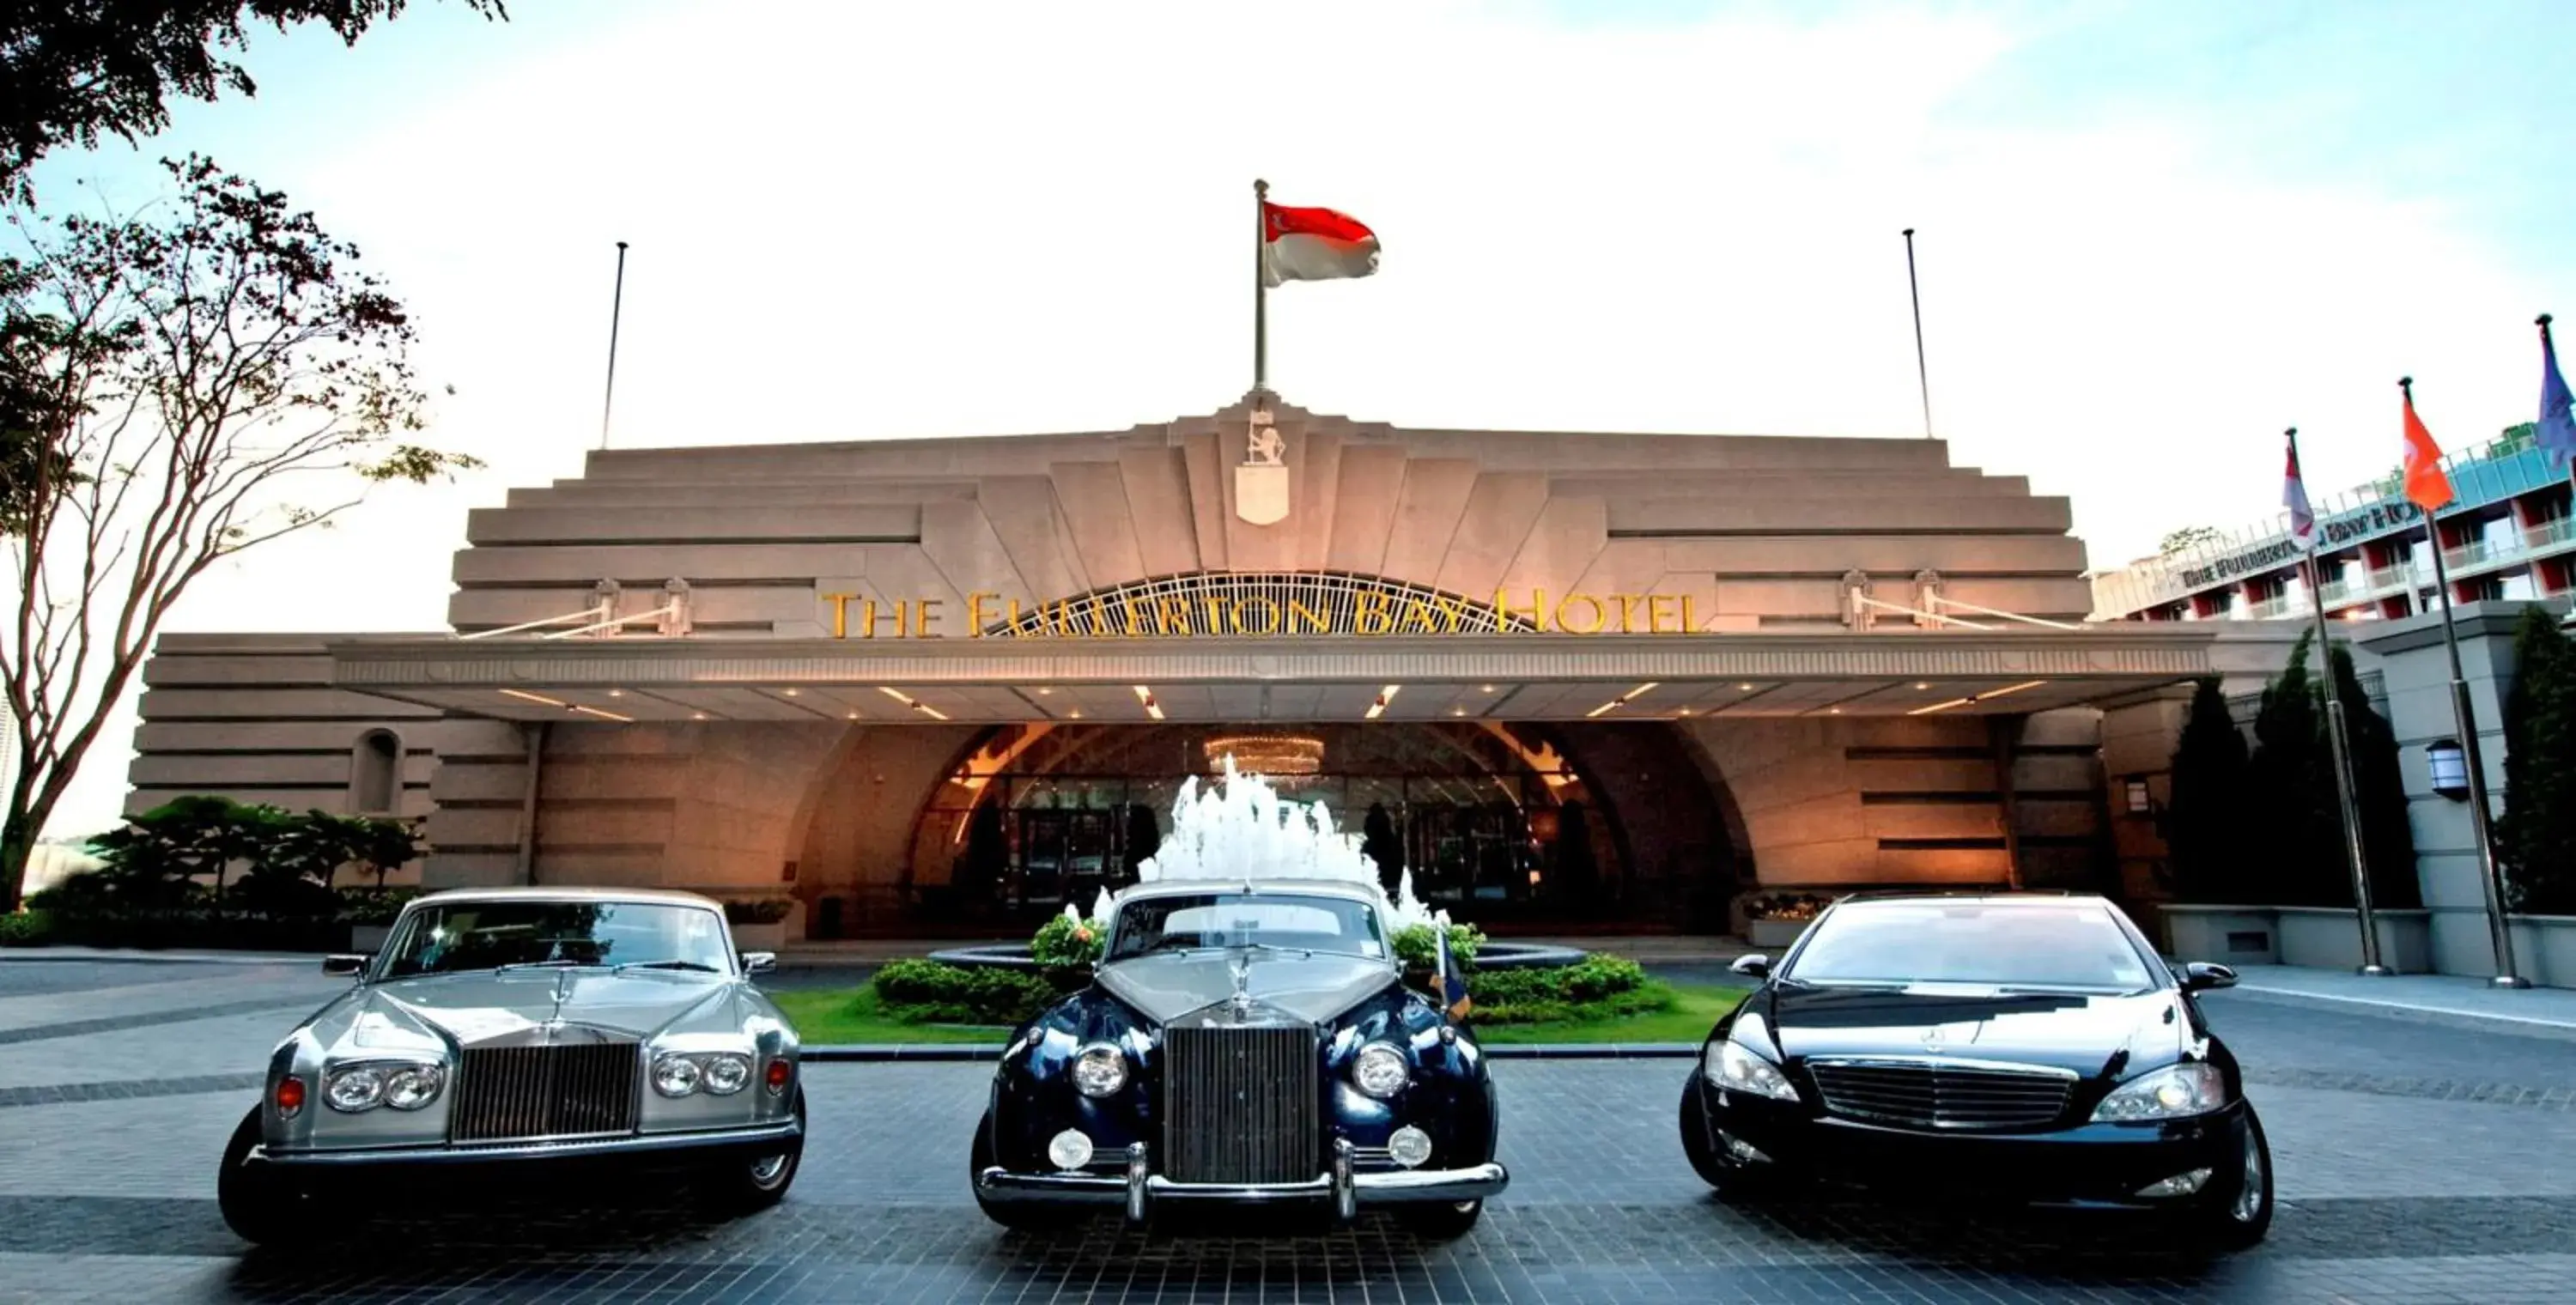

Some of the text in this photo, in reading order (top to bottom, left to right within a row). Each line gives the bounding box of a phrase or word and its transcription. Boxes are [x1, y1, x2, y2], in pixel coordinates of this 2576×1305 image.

[823, 587, 1716, 639] THE FULLERTON BAY HOTEL
